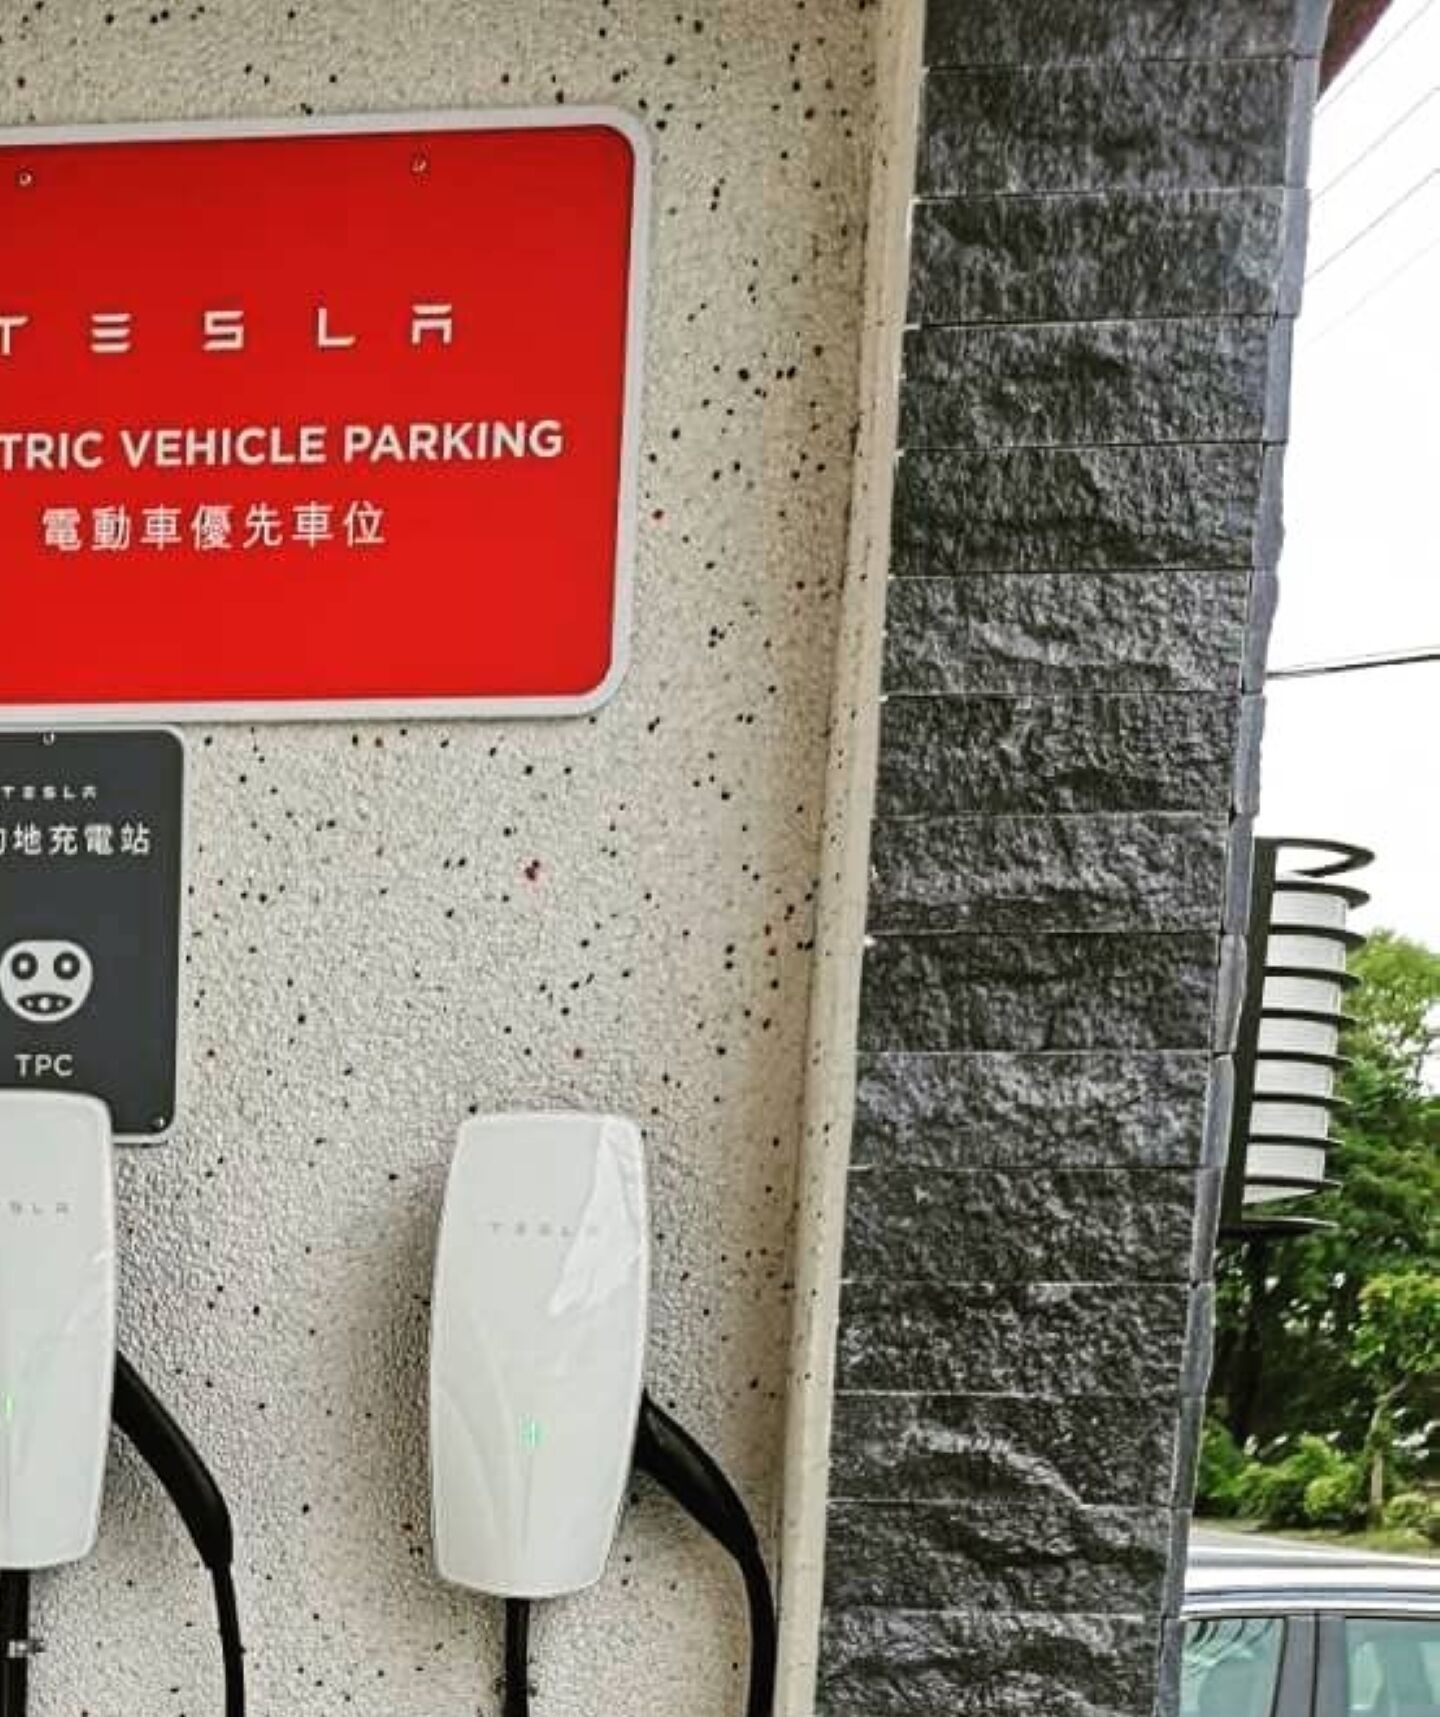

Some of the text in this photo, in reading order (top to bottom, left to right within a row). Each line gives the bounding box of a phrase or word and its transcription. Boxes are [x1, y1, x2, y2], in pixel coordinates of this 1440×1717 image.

[119, 425, 328, 469] VEHICLE
[343, 420, 564, 463] PARKING
[40, 500, 386, 552] 電動車優先車位
[1, 784, 98, 800] TESLA
[14, 1052, 74, 1078] TPC
